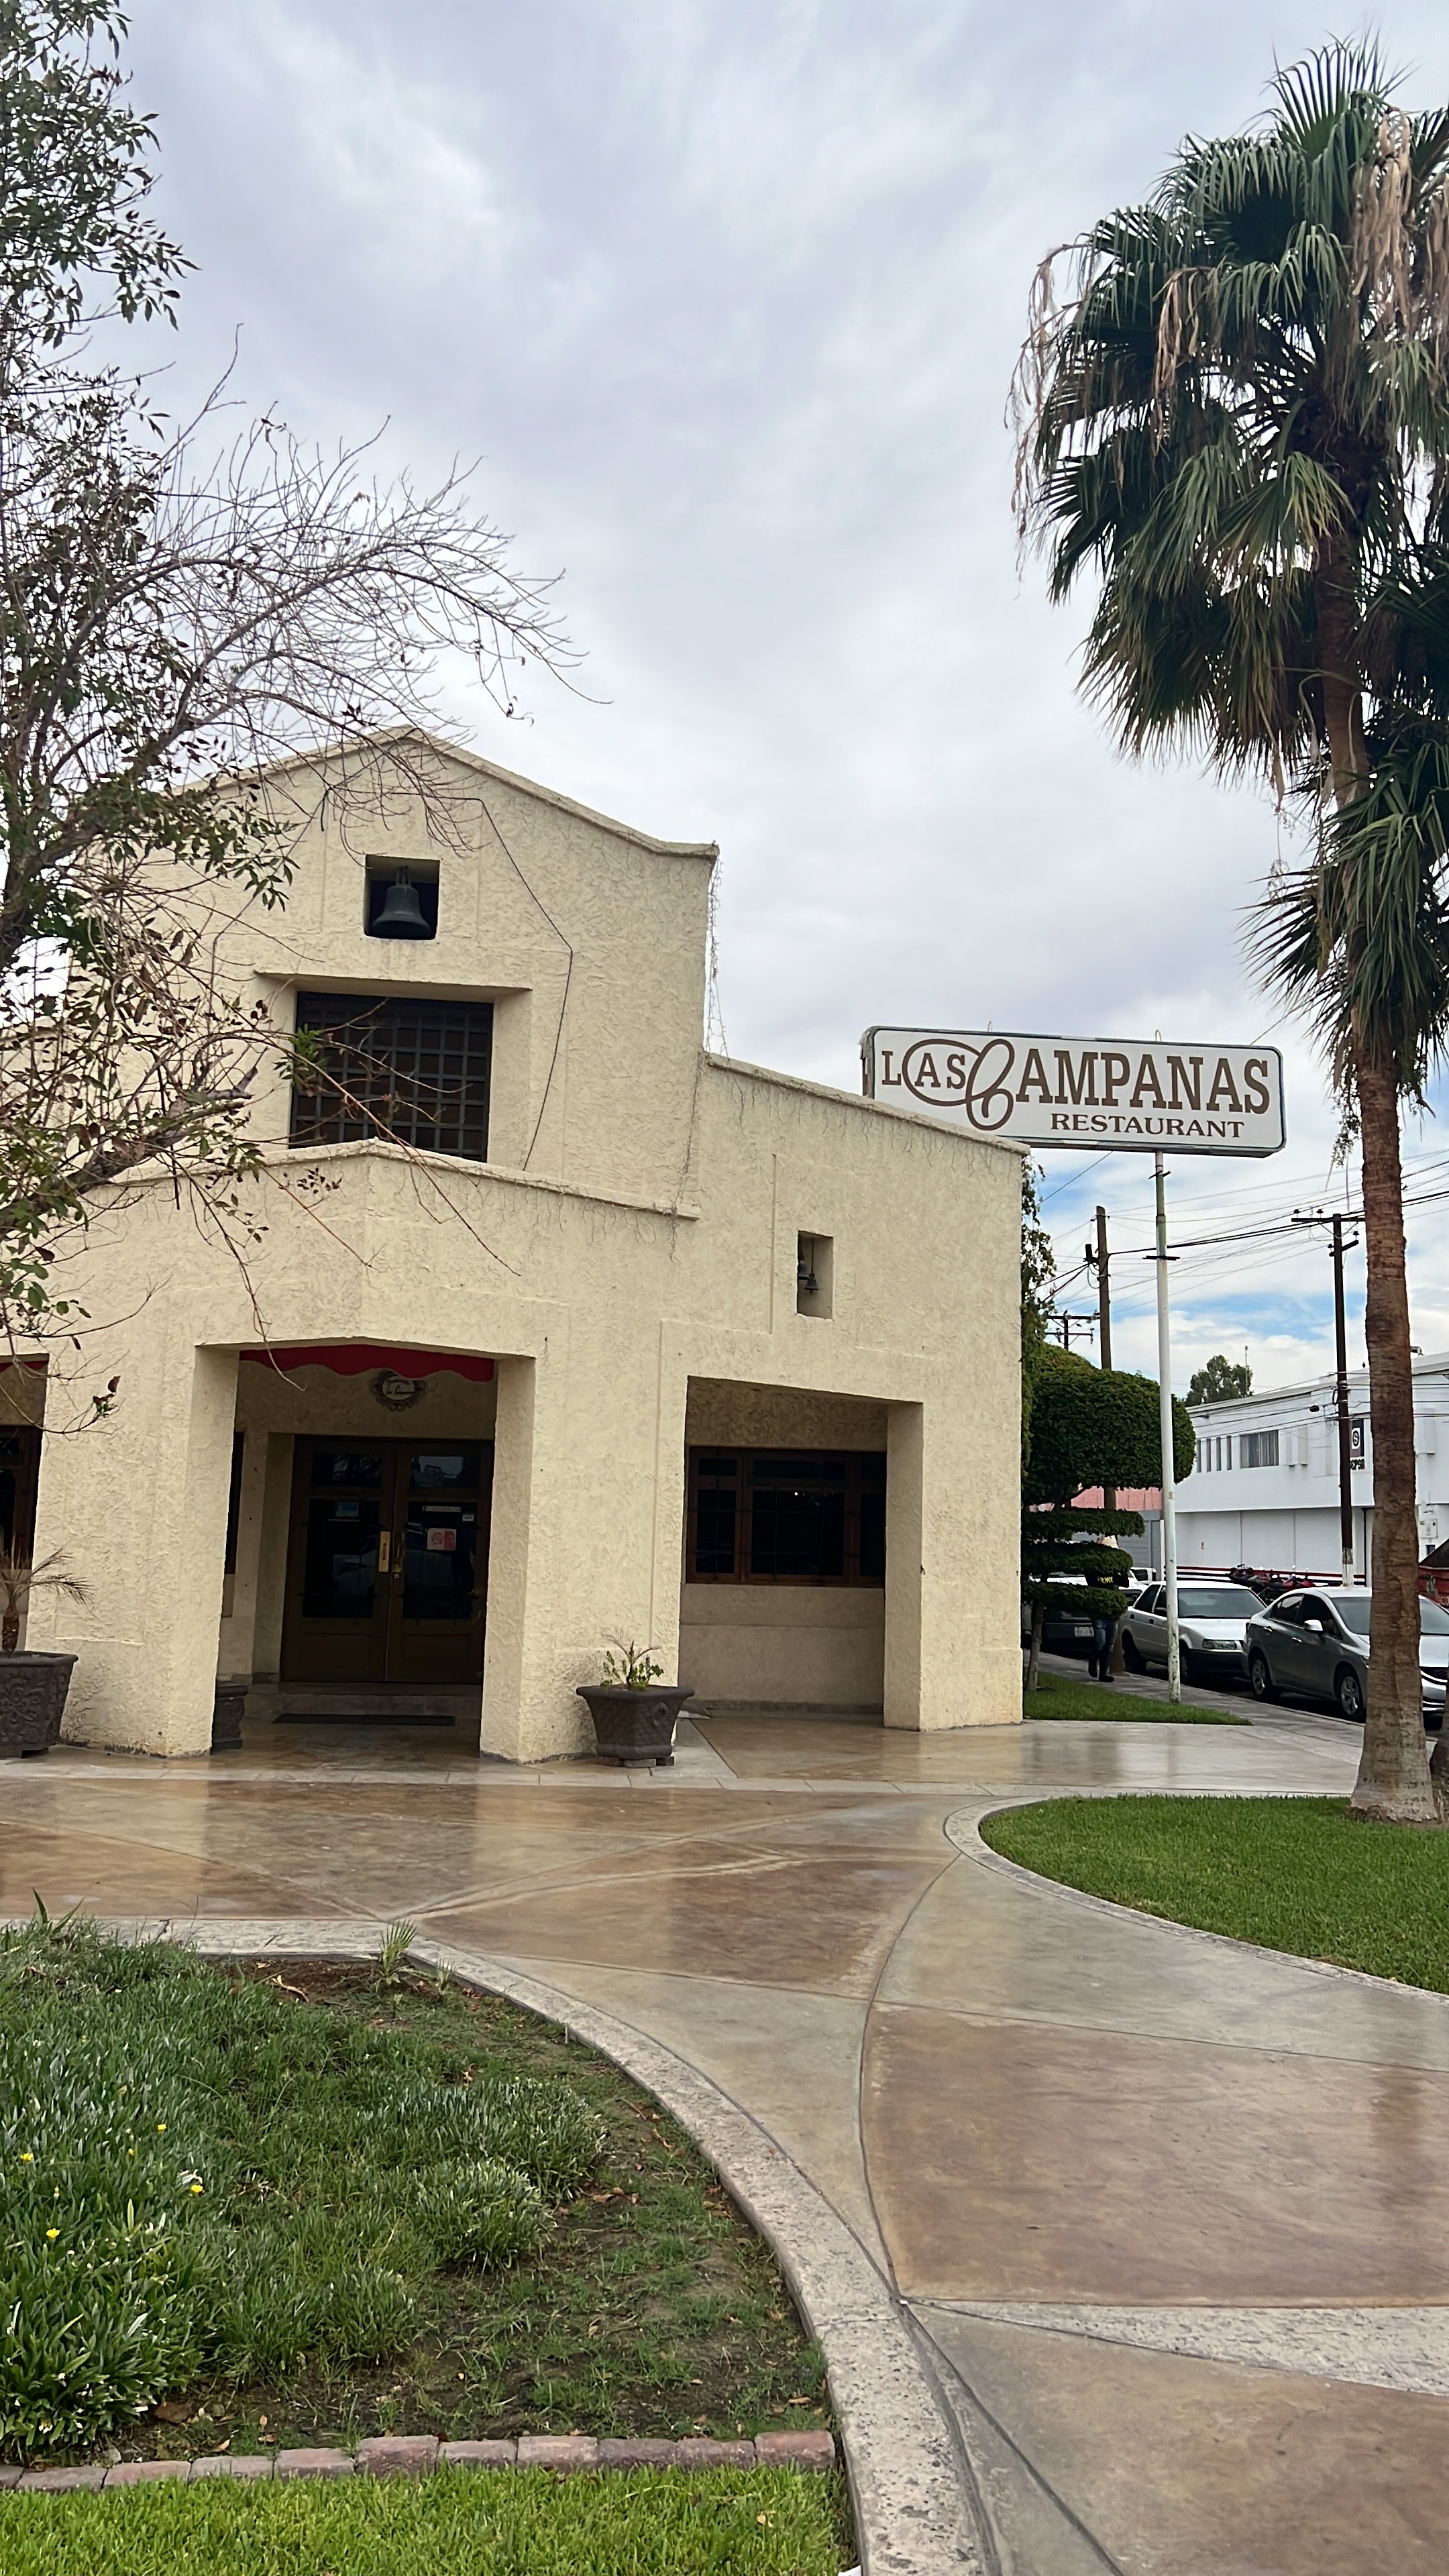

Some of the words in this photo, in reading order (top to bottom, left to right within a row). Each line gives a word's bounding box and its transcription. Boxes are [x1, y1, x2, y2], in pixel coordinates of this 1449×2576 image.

[881, 1051, 967, 1089] LAS
[966, 1039, 1271, 1131] CAMPANAS
[1051, 1113, 1244, 1138] RESTAURANT
